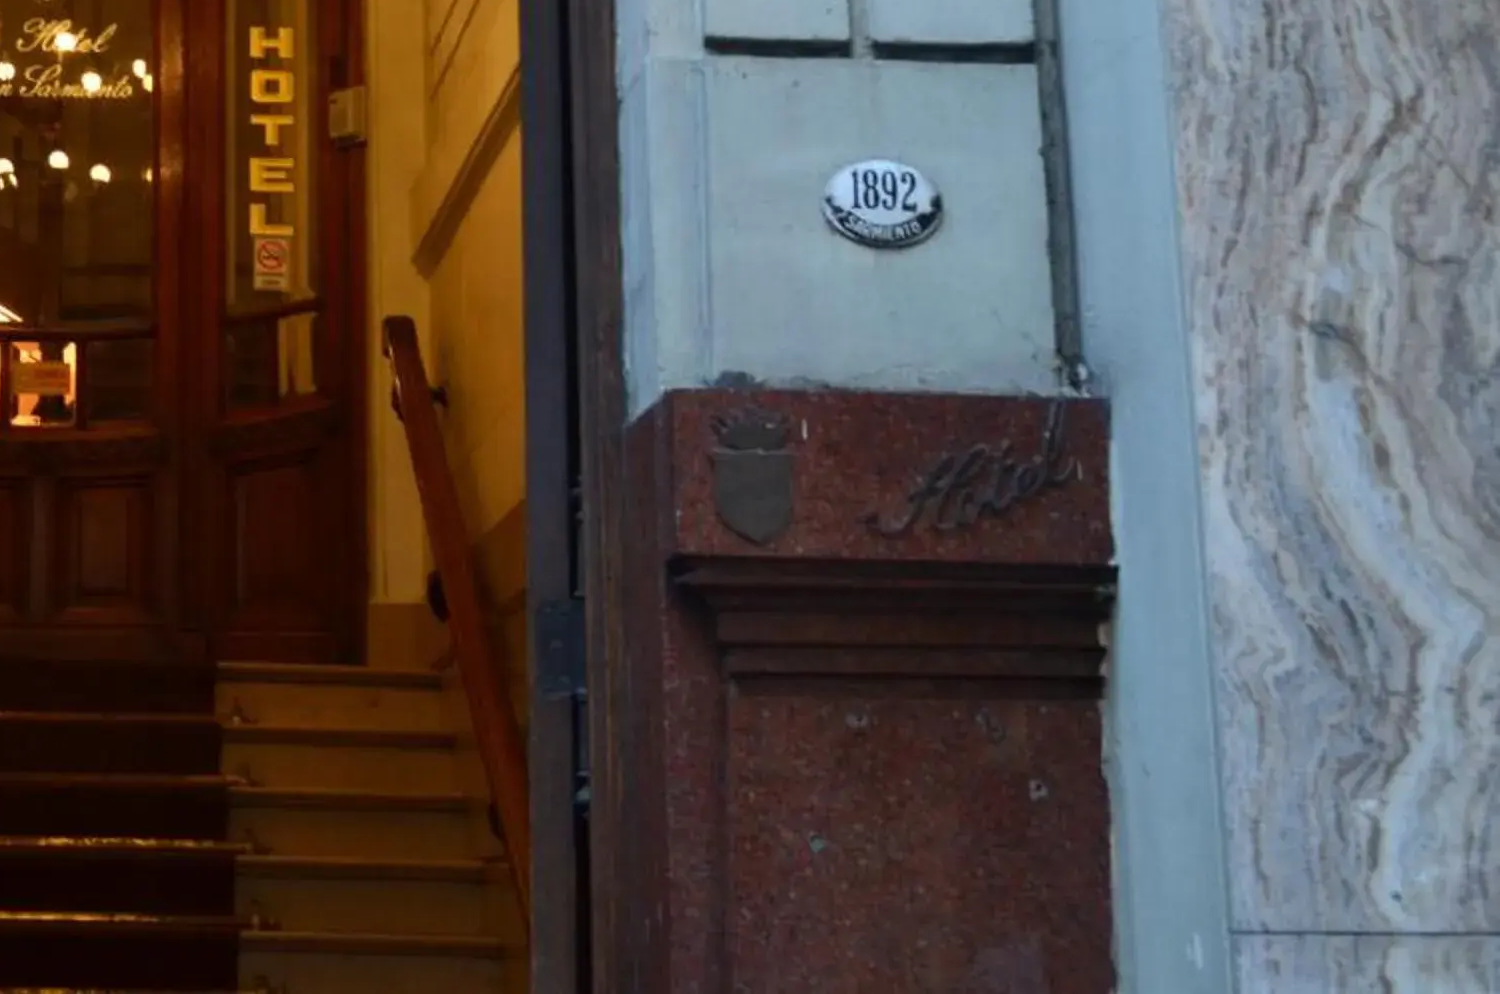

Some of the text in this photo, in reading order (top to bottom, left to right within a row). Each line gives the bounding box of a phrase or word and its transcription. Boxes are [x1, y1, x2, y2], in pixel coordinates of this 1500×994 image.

[16, 17, 118, 53] Htel
[19, 62, 134, 99] Sarmnto
[249, 26, 295, 236] HOTEL
[851, 169, 918, 212] 1892
